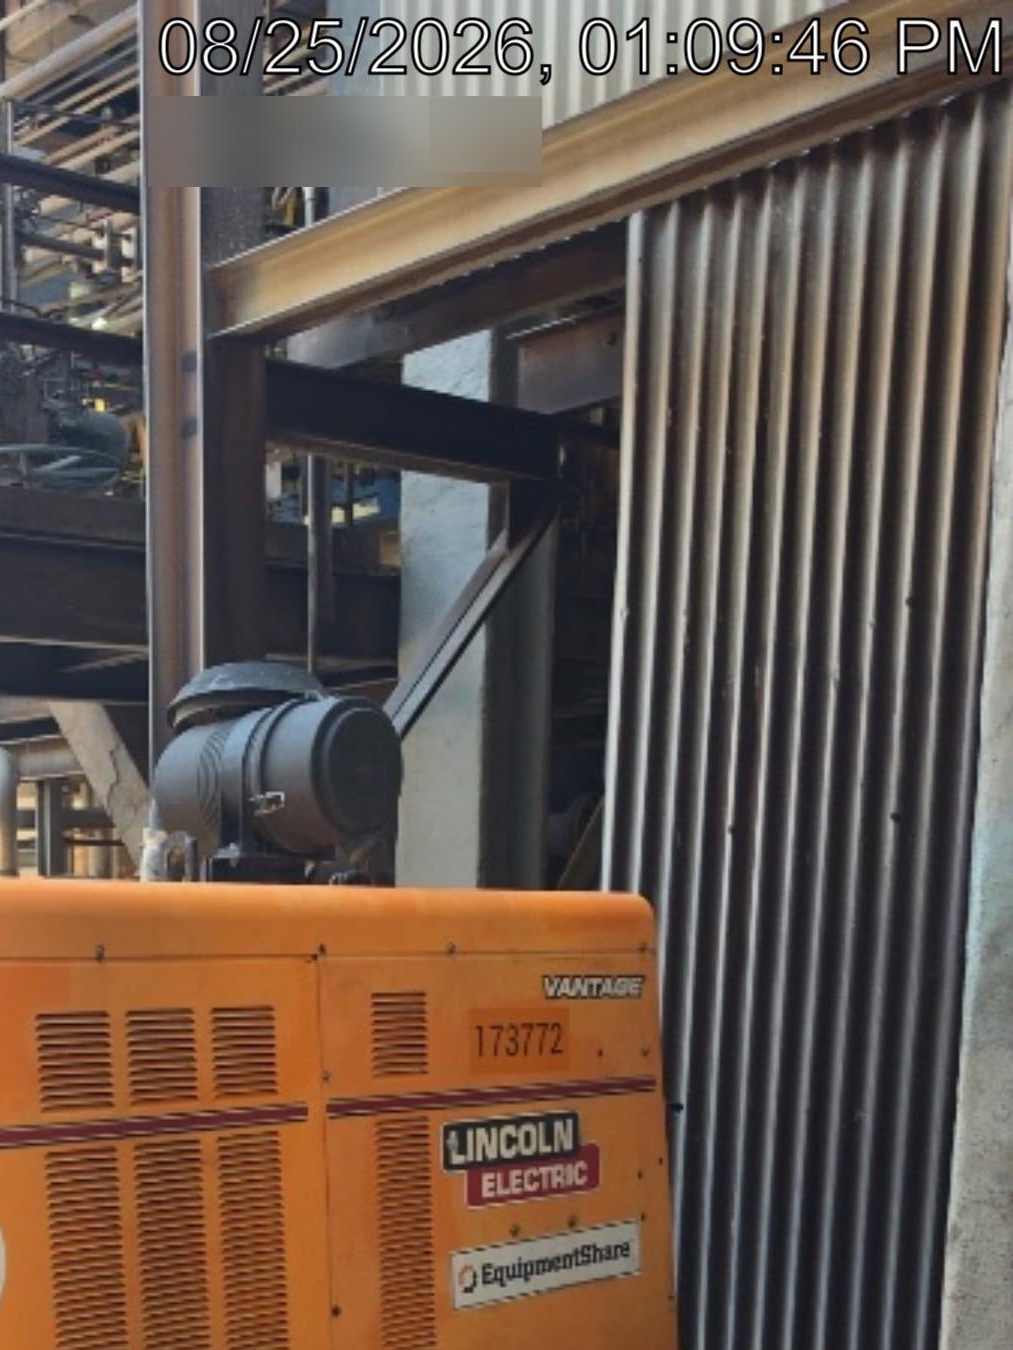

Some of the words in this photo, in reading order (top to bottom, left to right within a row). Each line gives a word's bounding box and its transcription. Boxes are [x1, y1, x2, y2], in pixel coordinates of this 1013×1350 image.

[543, 976, 643, 999] VANTAGE
[475, 1023, 565, 1058] 173772
[445, 1118, 575, 1165] LINCOLN
[481, 1160, 589, 1198] ELECTRIC
[481, 1241, 631, 1286] EquipmentShare
